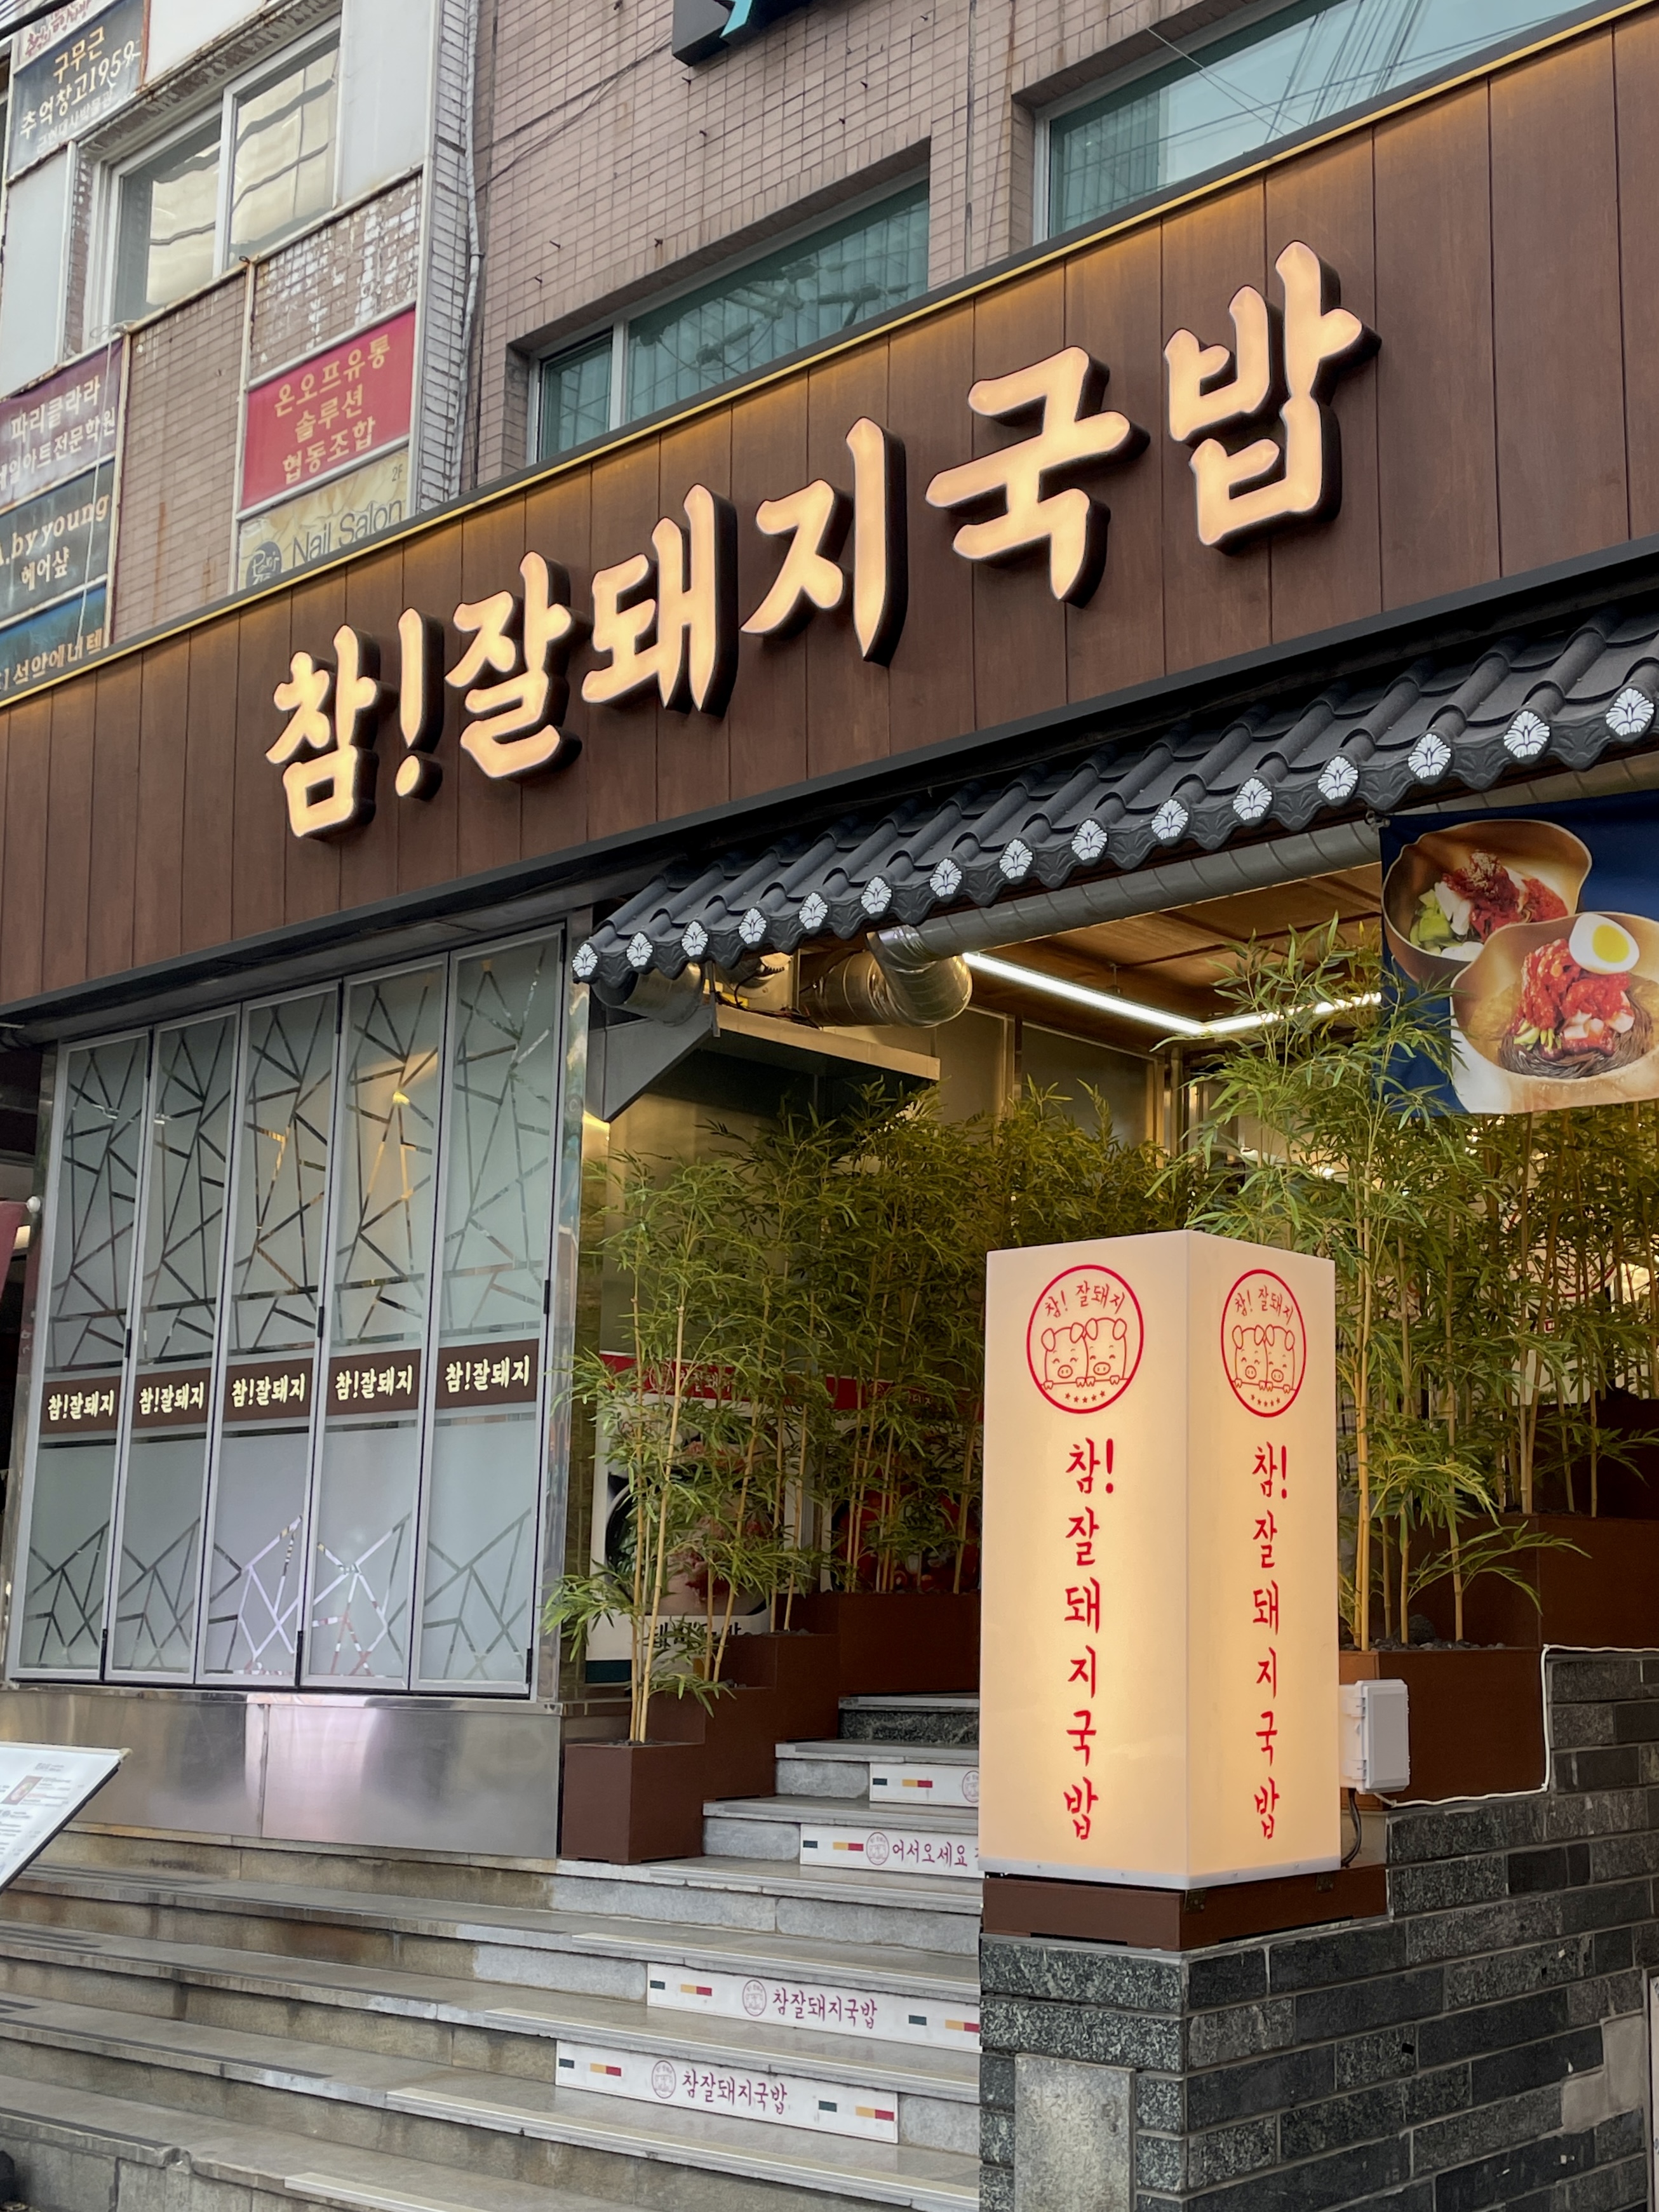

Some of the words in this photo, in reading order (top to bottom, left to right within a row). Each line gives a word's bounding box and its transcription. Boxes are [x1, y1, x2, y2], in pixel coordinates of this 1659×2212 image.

[274, 334, 390, 417] 온오프유통
[295, 384, 363, 443] 솔루션
[283, 416, 375, 485] 협동조합
[392, 464, 403, 482] 2F
[292, 521, 331, 566] Nail
[339, 500, 402, 547] Salon
[892, 1839, 968, 1867] 어서오세요
